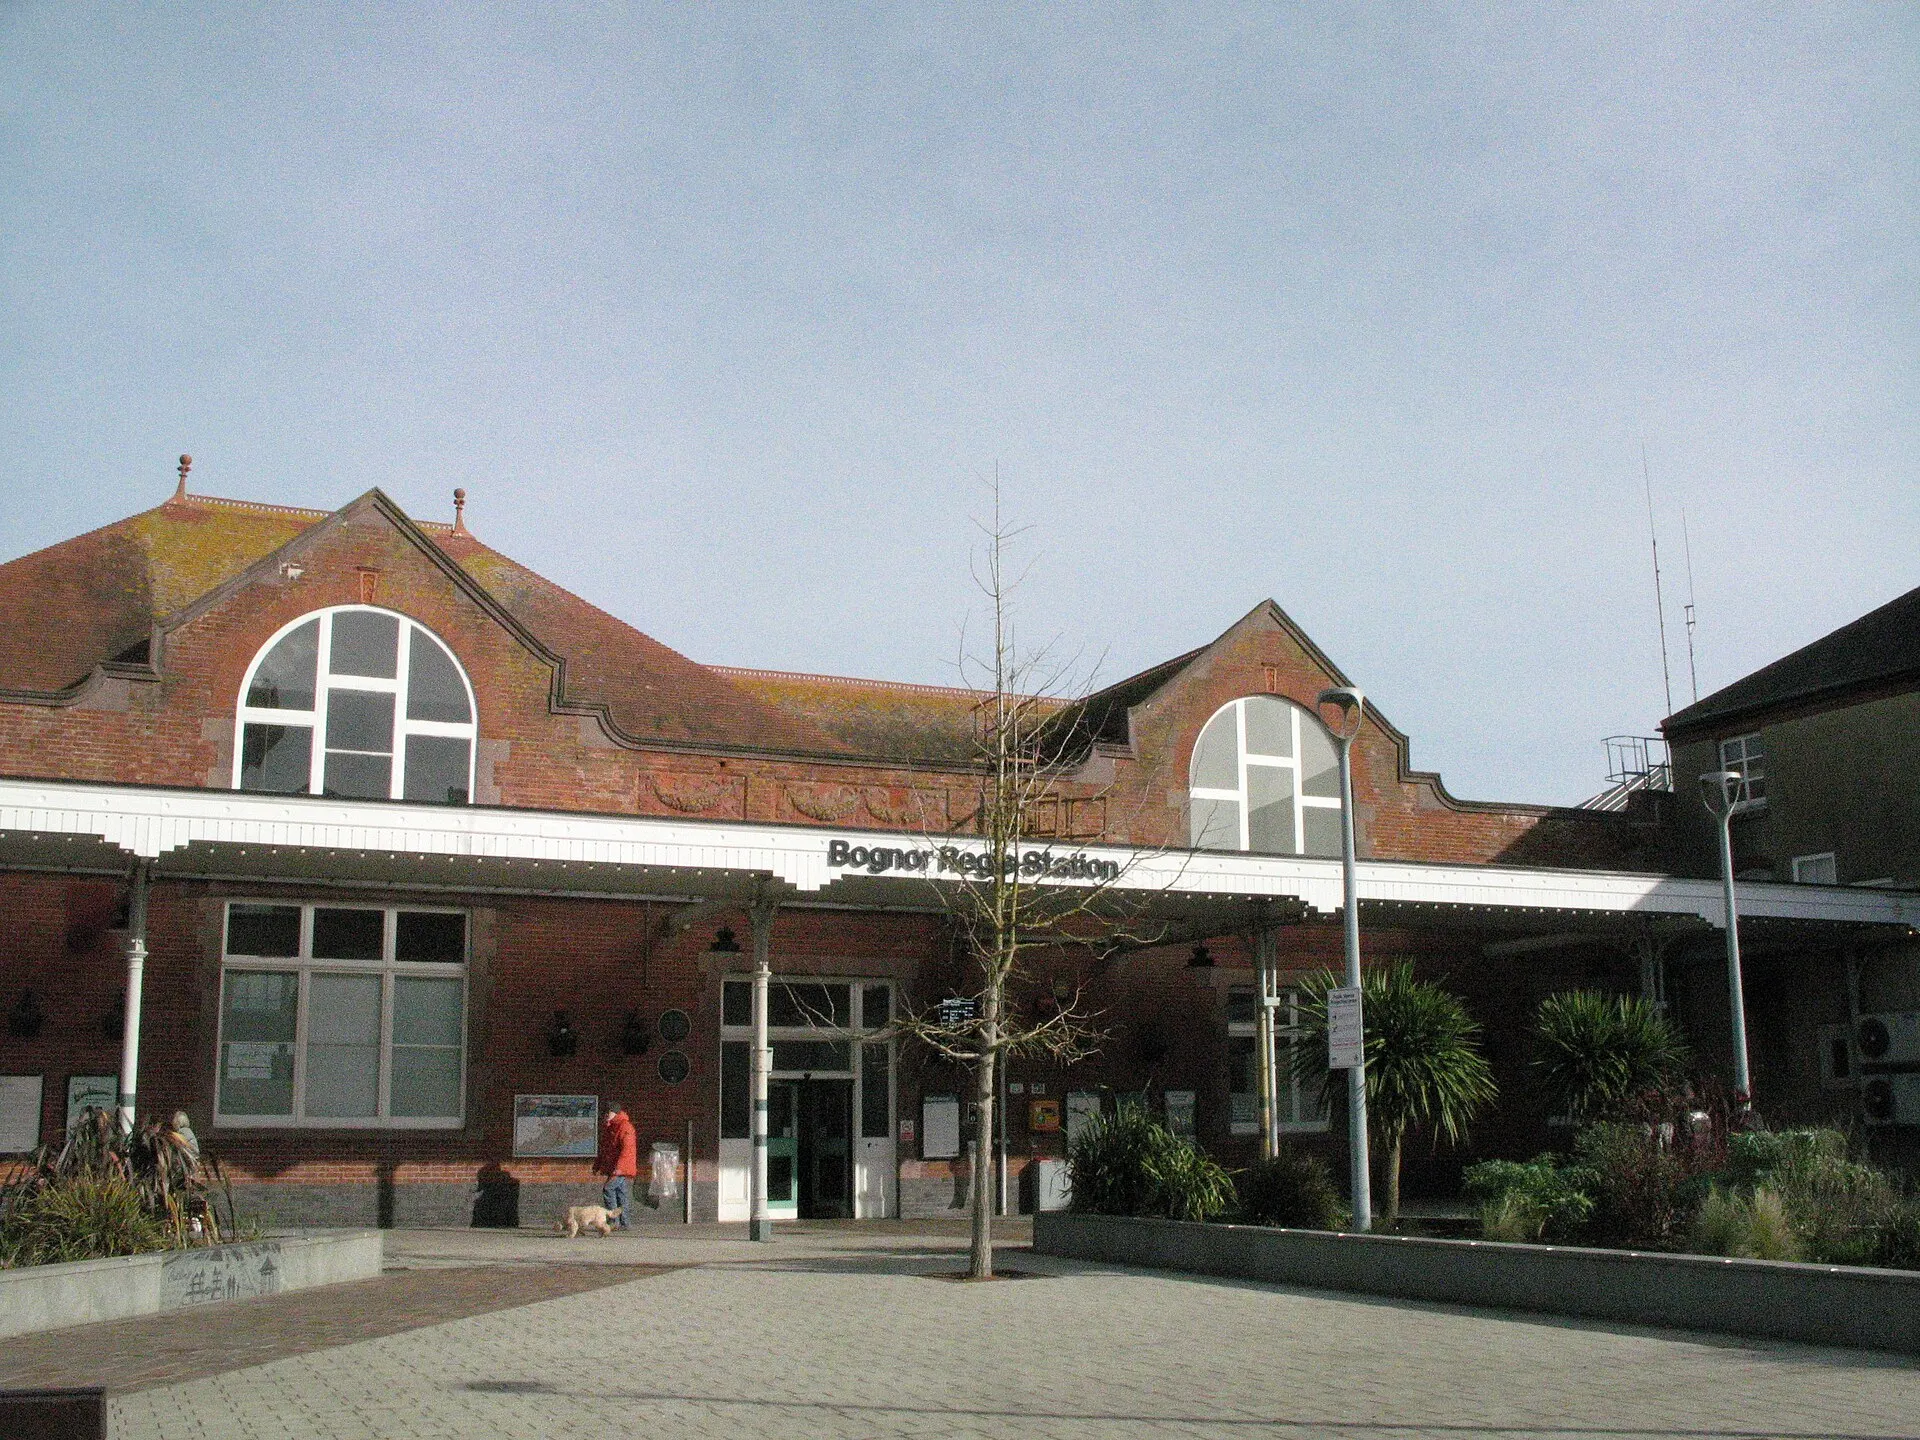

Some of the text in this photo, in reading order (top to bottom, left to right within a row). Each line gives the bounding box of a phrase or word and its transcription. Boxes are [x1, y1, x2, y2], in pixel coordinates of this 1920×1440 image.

[827, 839, 1119, 880] Bognor Regs Station
